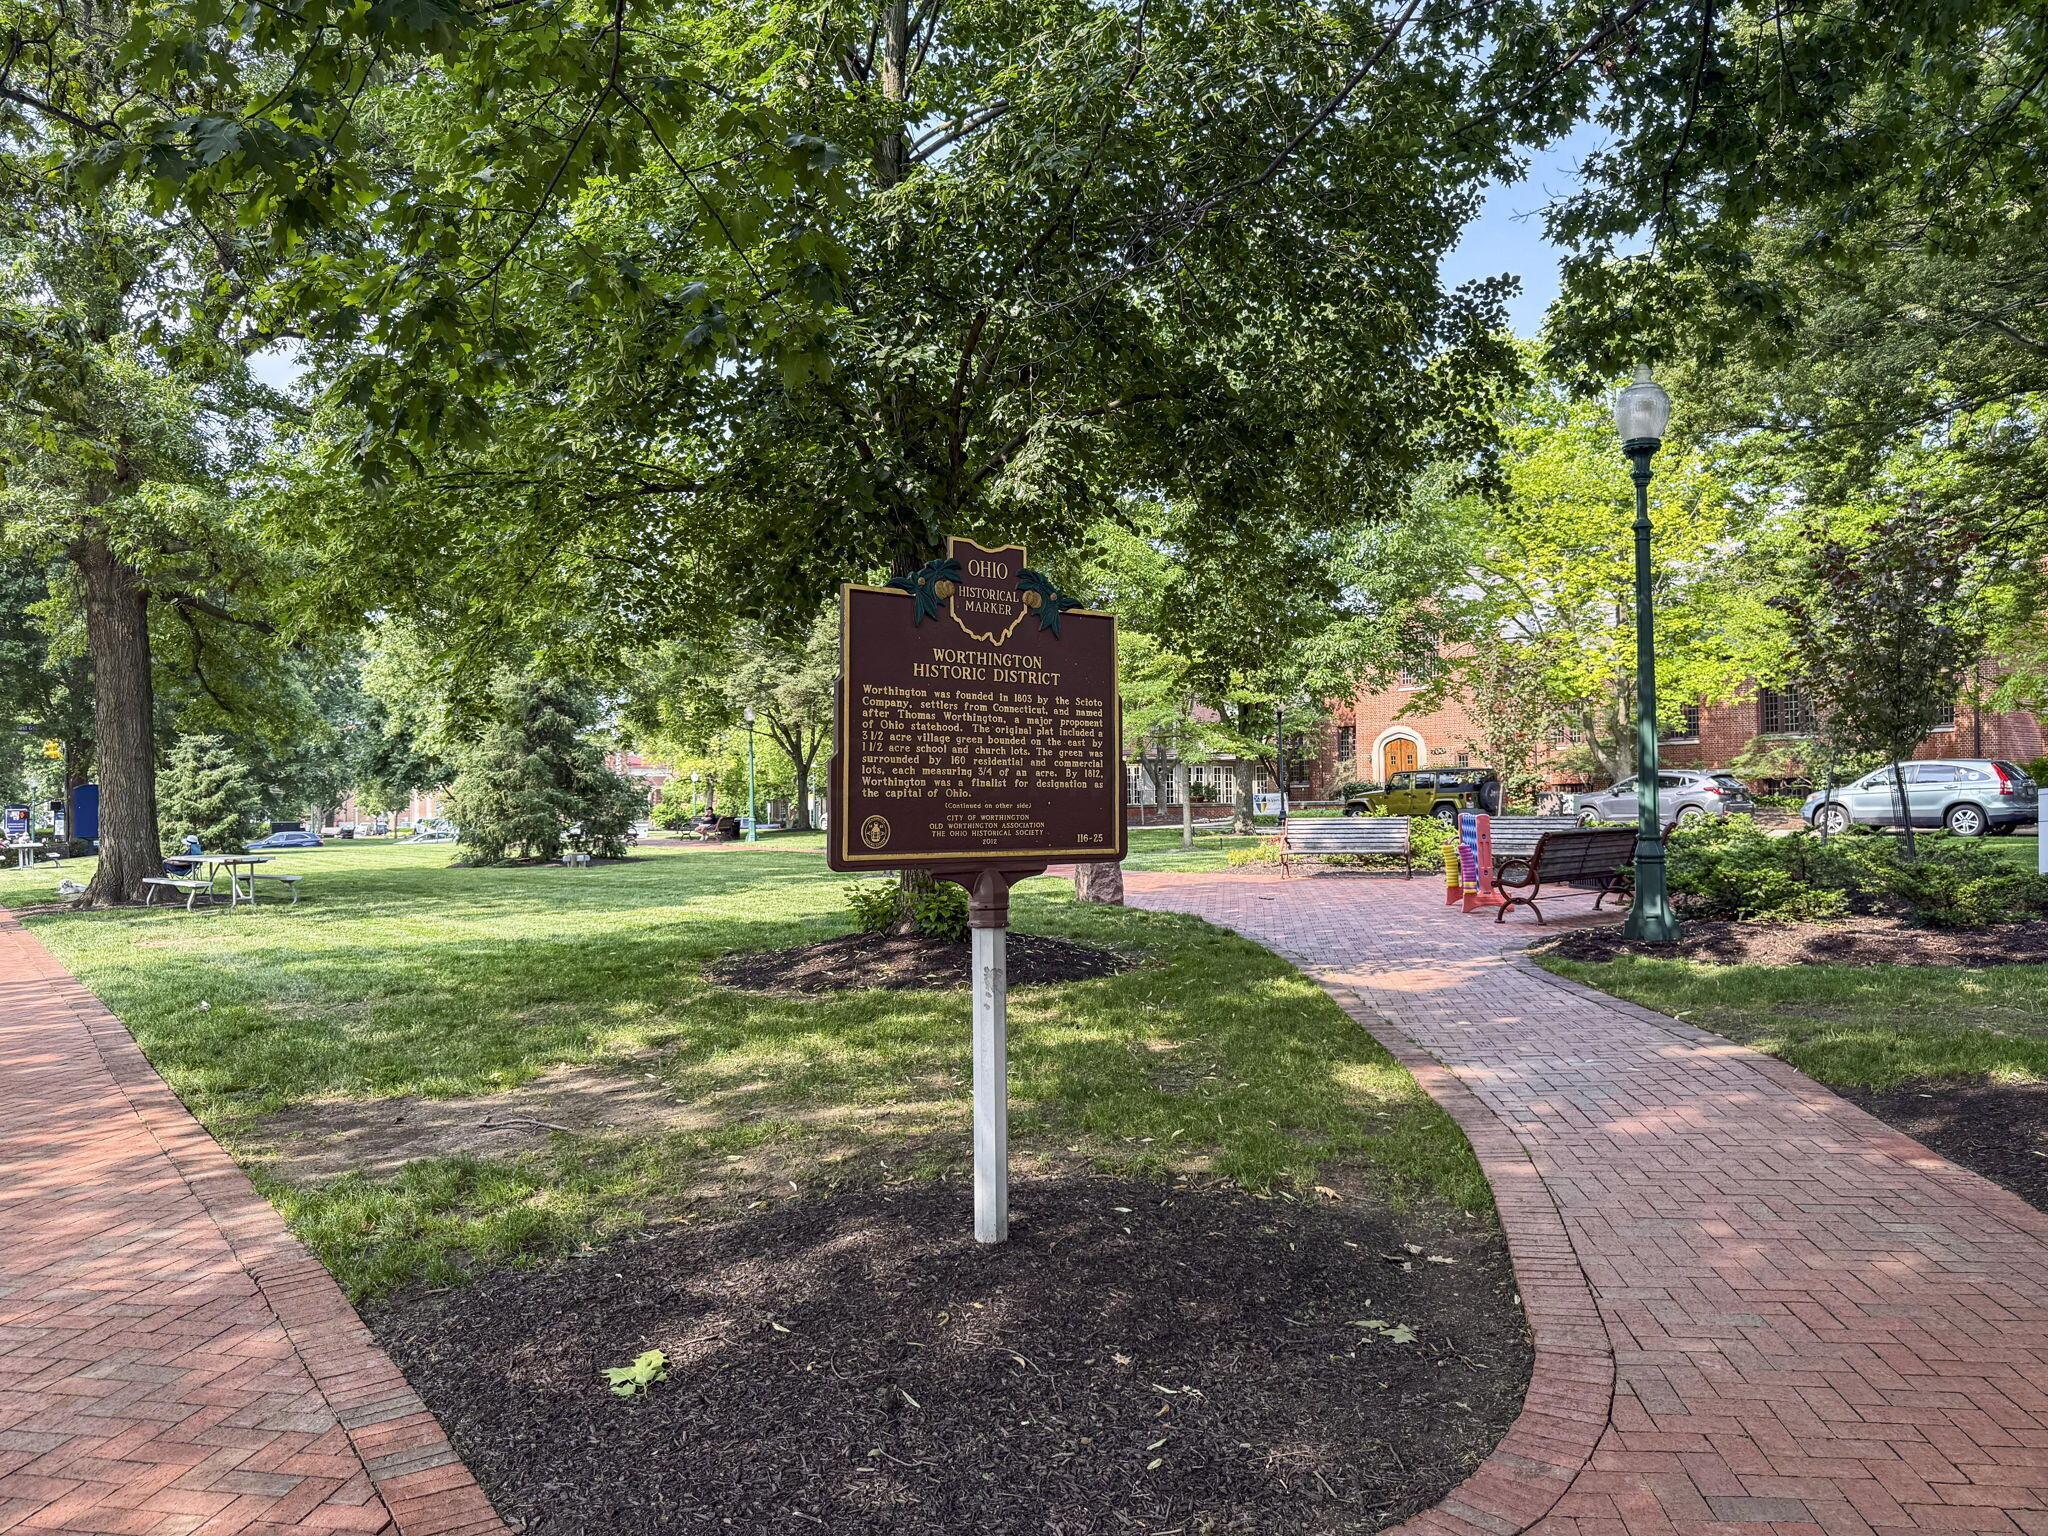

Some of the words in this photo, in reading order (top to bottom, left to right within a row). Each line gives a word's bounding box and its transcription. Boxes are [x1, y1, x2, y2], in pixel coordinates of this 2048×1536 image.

[968, 560, 1008, 579] OHIO
[959, 586, 1019, 602] HISTORICAL
[965, 601, 1012, 616] MARKER
[933, 648, 1042, 669] WORTHINGTON
[913, 663, 986, 680] HISTORIC
[994, 669, 1060, 686] DISTRICT
[863, 684, 927, 698] Worthington
[956, 691, 994, 701] founded
[1000, 693, 1008, 701] in
[1014, 694, 1032, 702] 1803
[1038, 695, 1048, 705] by
[1056, 697, 1070, 705] the
[1076, 698, 1102, 706] Scioto
[921, 700, 958, 710] settlers
[964, 702, 988, 711] from
[993, 704, 1048, 715] Connecticut,
[863, 709, 889, 718] after
[898, 710, 935, 720] Thomas
[1027, 717, 1052, 726] major
[1061, 719, 1103, 728] proponent
[863, 720, 874, 728] of
[880, 720, 904, 729] Ohio
[911, 722, 963, 732] statehood.
[972, 724, 990, 733] The
[996, 726, 1031, 735] original
[1037, 727, 1054, 737] plat
[1060, 728, 1094, 737] included
[917, 733, 950, 744] village
[956, 736, 983, 745] green
[988, 736, 1026, 745] bounded
[1092, 739, 1103, 748] by
[916, 744, 946, 753] school
[952, 745, 968, 754] and
[975, 746, 1006, 755] church
[1011, 747, 1030, 755] lots.
[1036, 748, 1052, 756] The
[1059, 750, 1083, 758] green
[862, 755, 920, 764] surrounded
[929, 755, 941, 765] by
[951, 756, 965, 765] 160
[974, 757, 1023, 766] residential
[1031, 758, 1046, 766] and
[862, 765, 884, 775] lots,
[892, 766, 915, 775] each
[922, 767, 972, 777] measuring
[978, 767, 992, 776] 3/4
[999, 768, 1009, 776] of
[1066, 769, 1077, 779] By
[1085, 769, 1103, 778] 1812,
[862, 776, 926, 788] Worthington
[972, 778, 1006, 787] finalist
[1014, 779, 1028, 787] for
[1037, 780, 1087, 789] designation
[862, 788, 879, 797] the
[885, 789, 922, 799] capital
[928, 789, 939, 797] of
[946, 789, 972, 797] Ohio.
[1077, 834, 1103, 842] 116-25
